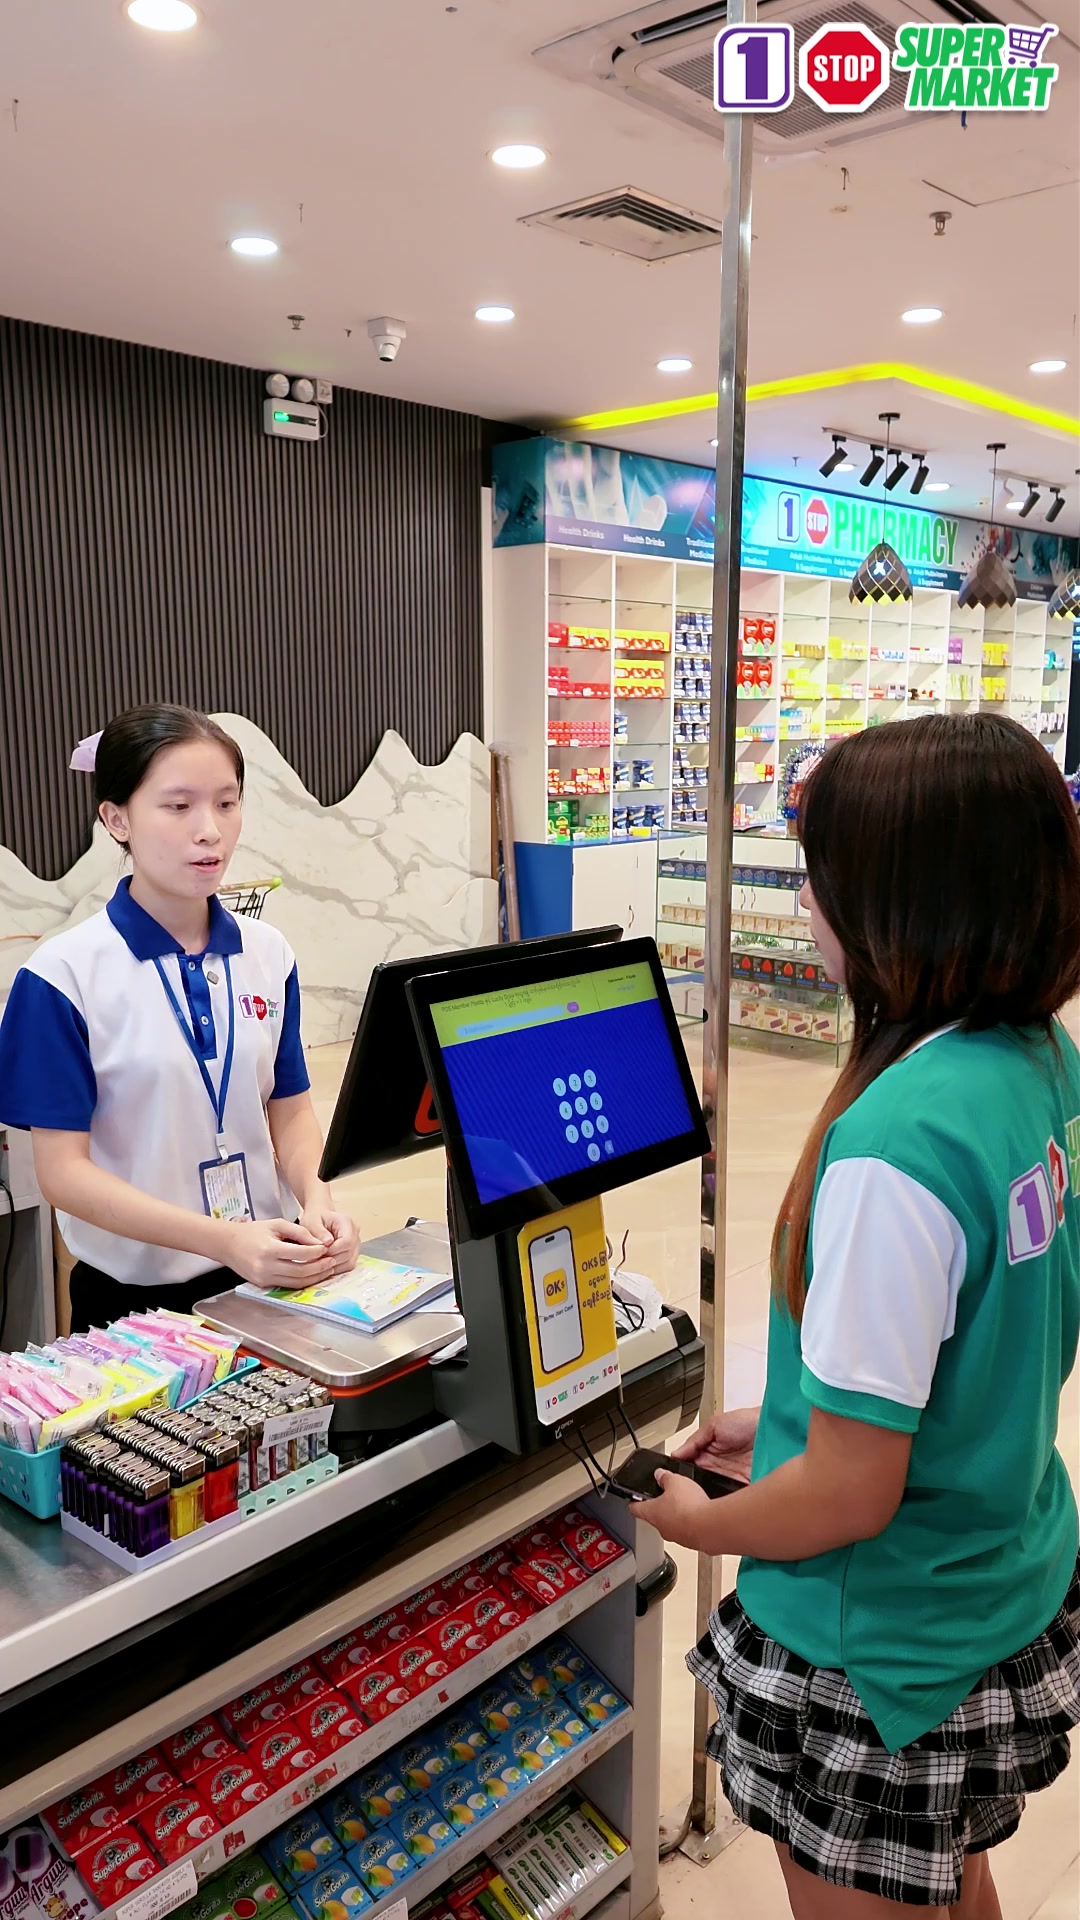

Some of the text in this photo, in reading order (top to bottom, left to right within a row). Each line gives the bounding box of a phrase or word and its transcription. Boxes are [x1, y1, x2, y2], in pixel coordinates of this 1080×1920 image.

[558, 526, 605, 540] Health Drinks
[623, 533, 666, 547] Health Drinks
[784, 498, 958, 566] 1 STOP PHARMACY
[1016, 1180, 1047, 1248] 1
[262, 1749, 283, 1770] Super
[212, 1783, 232, 1804] Super
[58, 1808, 81, 1829] Super
[156, 1818, 177, 1840] Super
[92, 1861, 116, 1883] Super
[314, 1888, 332, 1908] Super
